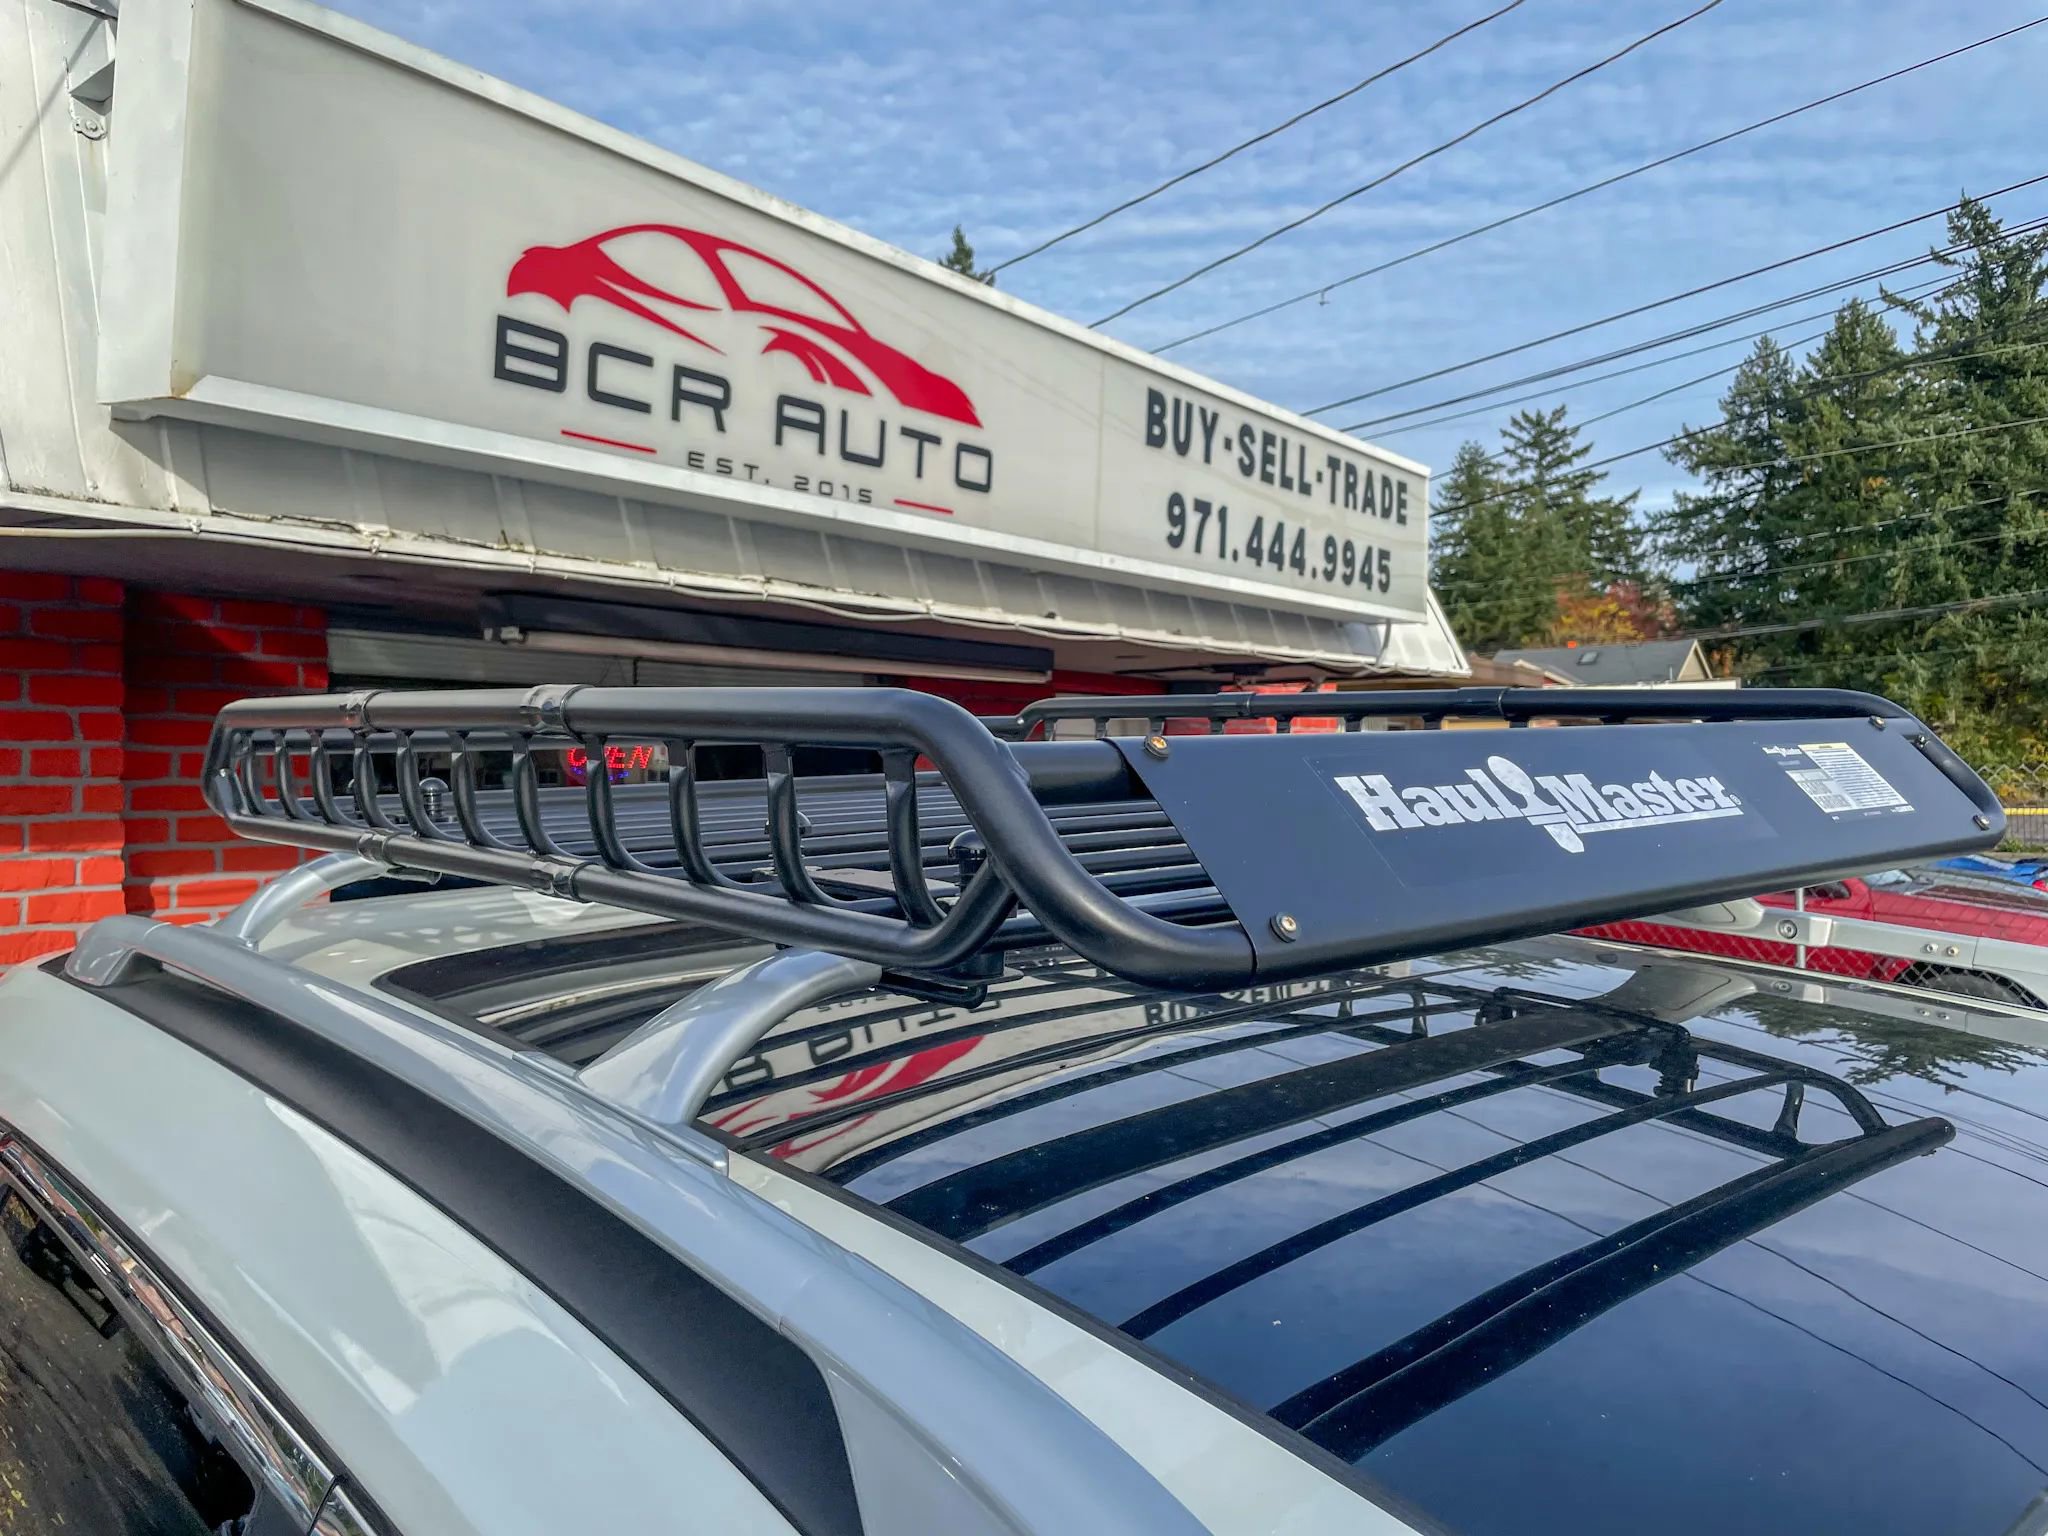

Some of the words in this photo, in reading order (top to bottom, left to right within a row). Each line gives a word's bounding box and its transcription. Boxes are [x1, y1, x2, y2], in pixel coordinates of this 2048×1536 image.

[494, 314, 732, 433] BCR
[775, 394, 993, 494] AUTO
[688, 451, 771, 484] EST.
[794, 474, 873, 503] 2015
[1166, 491, 1391, 594] 971.444.9945
